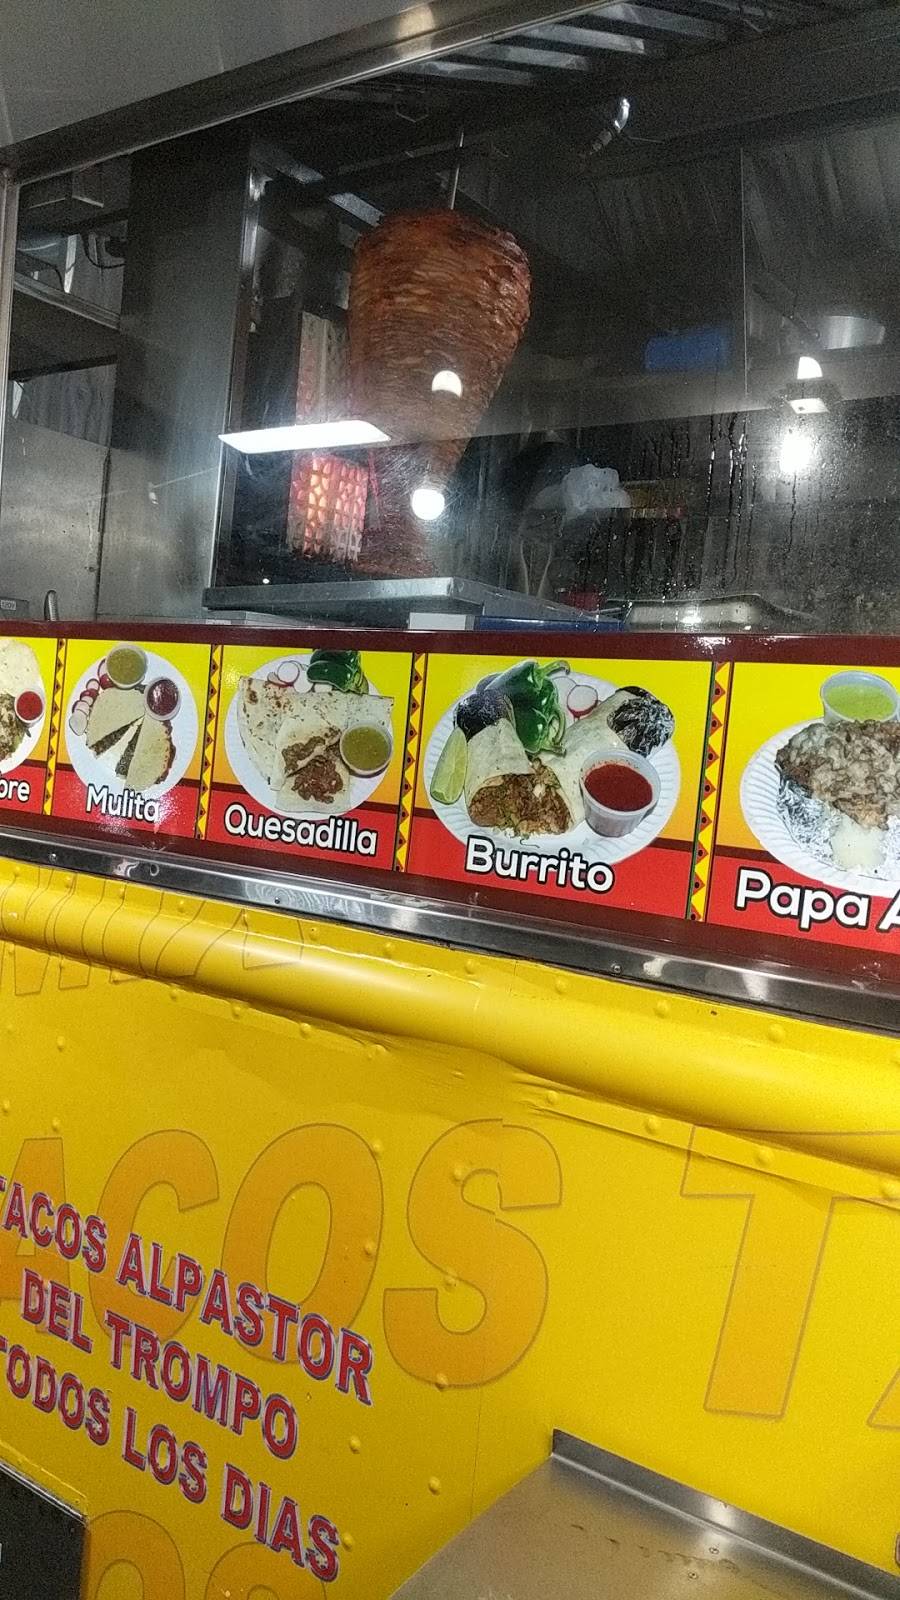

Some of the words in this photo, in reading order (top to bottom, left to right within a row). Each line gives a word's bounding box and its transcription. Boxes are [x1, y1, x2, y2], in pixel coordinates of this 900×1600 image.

[86, 784, 161, 823] Mulita
[224, 805, 378, 856] Quesadilla
[464, 834, 615, 893] Burrito
[735, 867, 871, 931] Papa
[0, 1174, 107, 1274] ACOS
[115, 1232, 374, 1406] ALPASTOR
[21, 1267, 93, 1354] DEL
[105, 1309, 299, 1461] TROMPO
[121, 1406, 208, 1504] LOS
[220, 1461, 341, 1582] DIAS
